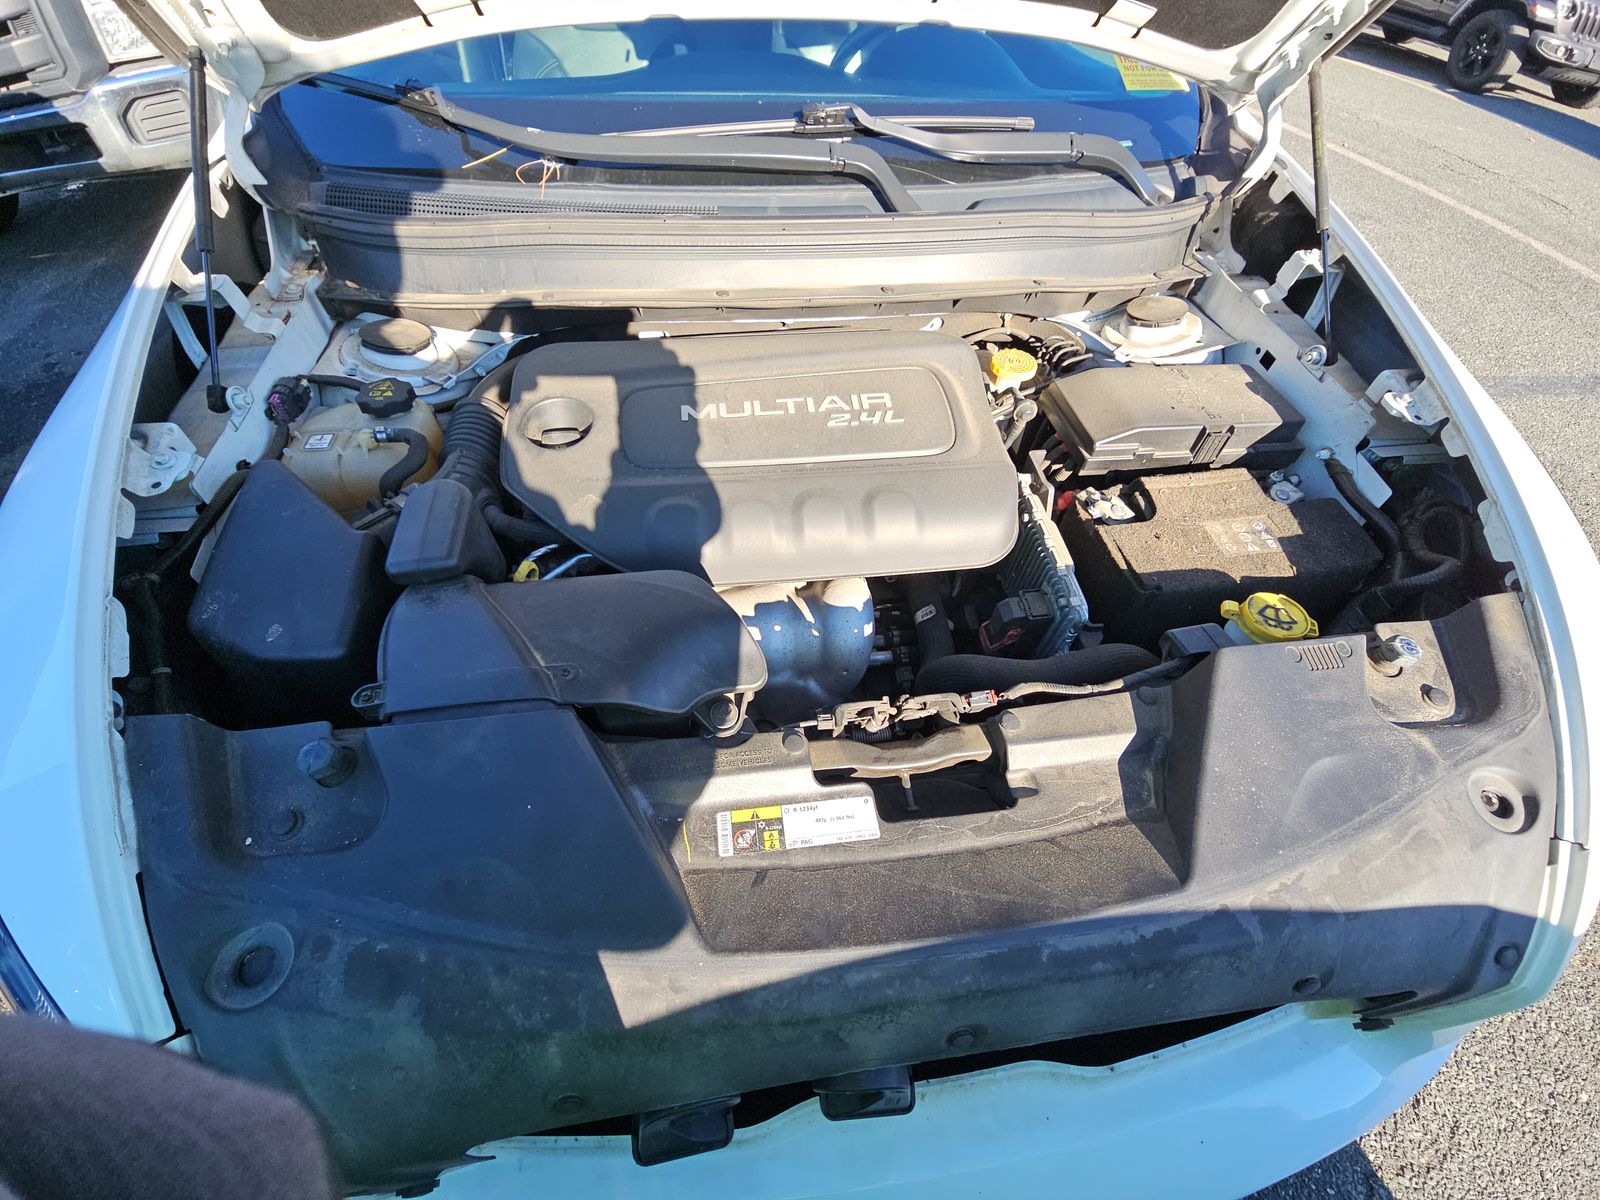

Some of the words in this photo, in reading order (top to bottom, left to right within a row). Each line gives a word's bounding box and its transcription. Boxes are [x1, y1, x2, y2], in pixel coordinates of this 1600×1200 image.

[680, 392, 893, 421] MULTIAIR
[826, 410, 905, 427] 2.4L
[737, 756, 772, 766] VEHICLES
